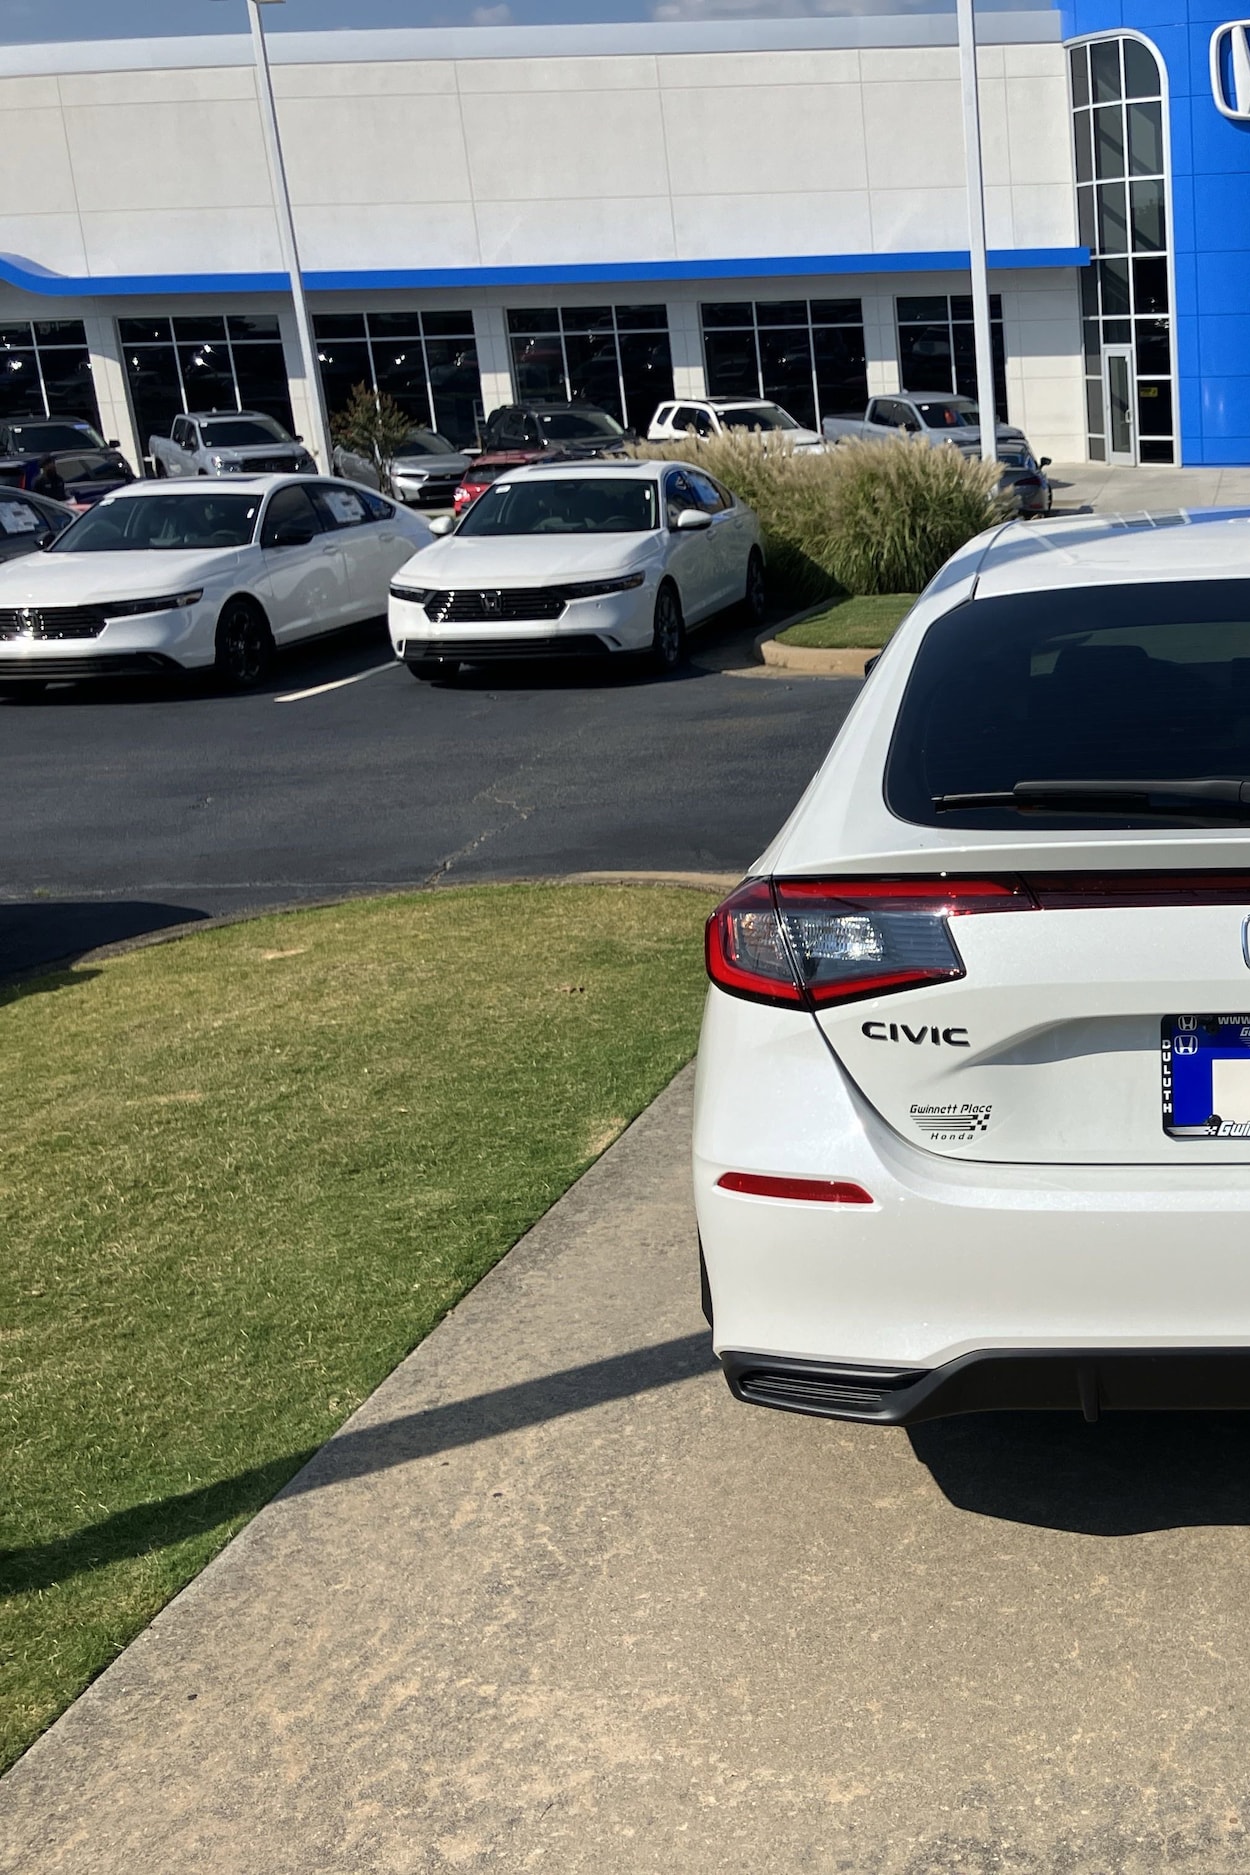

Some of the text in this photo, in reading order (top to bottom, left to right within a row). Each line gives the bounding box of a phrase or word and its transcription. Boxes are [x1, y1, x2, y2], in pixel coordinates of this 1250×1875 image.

[861, 1021, 970, 1047] CIVIC
[1161, 1039, 1173, 1114] DULUTH
[910, 1103, 993, 1114] Gwinnett Place
[930, 1132, 973, 1141] Honda
